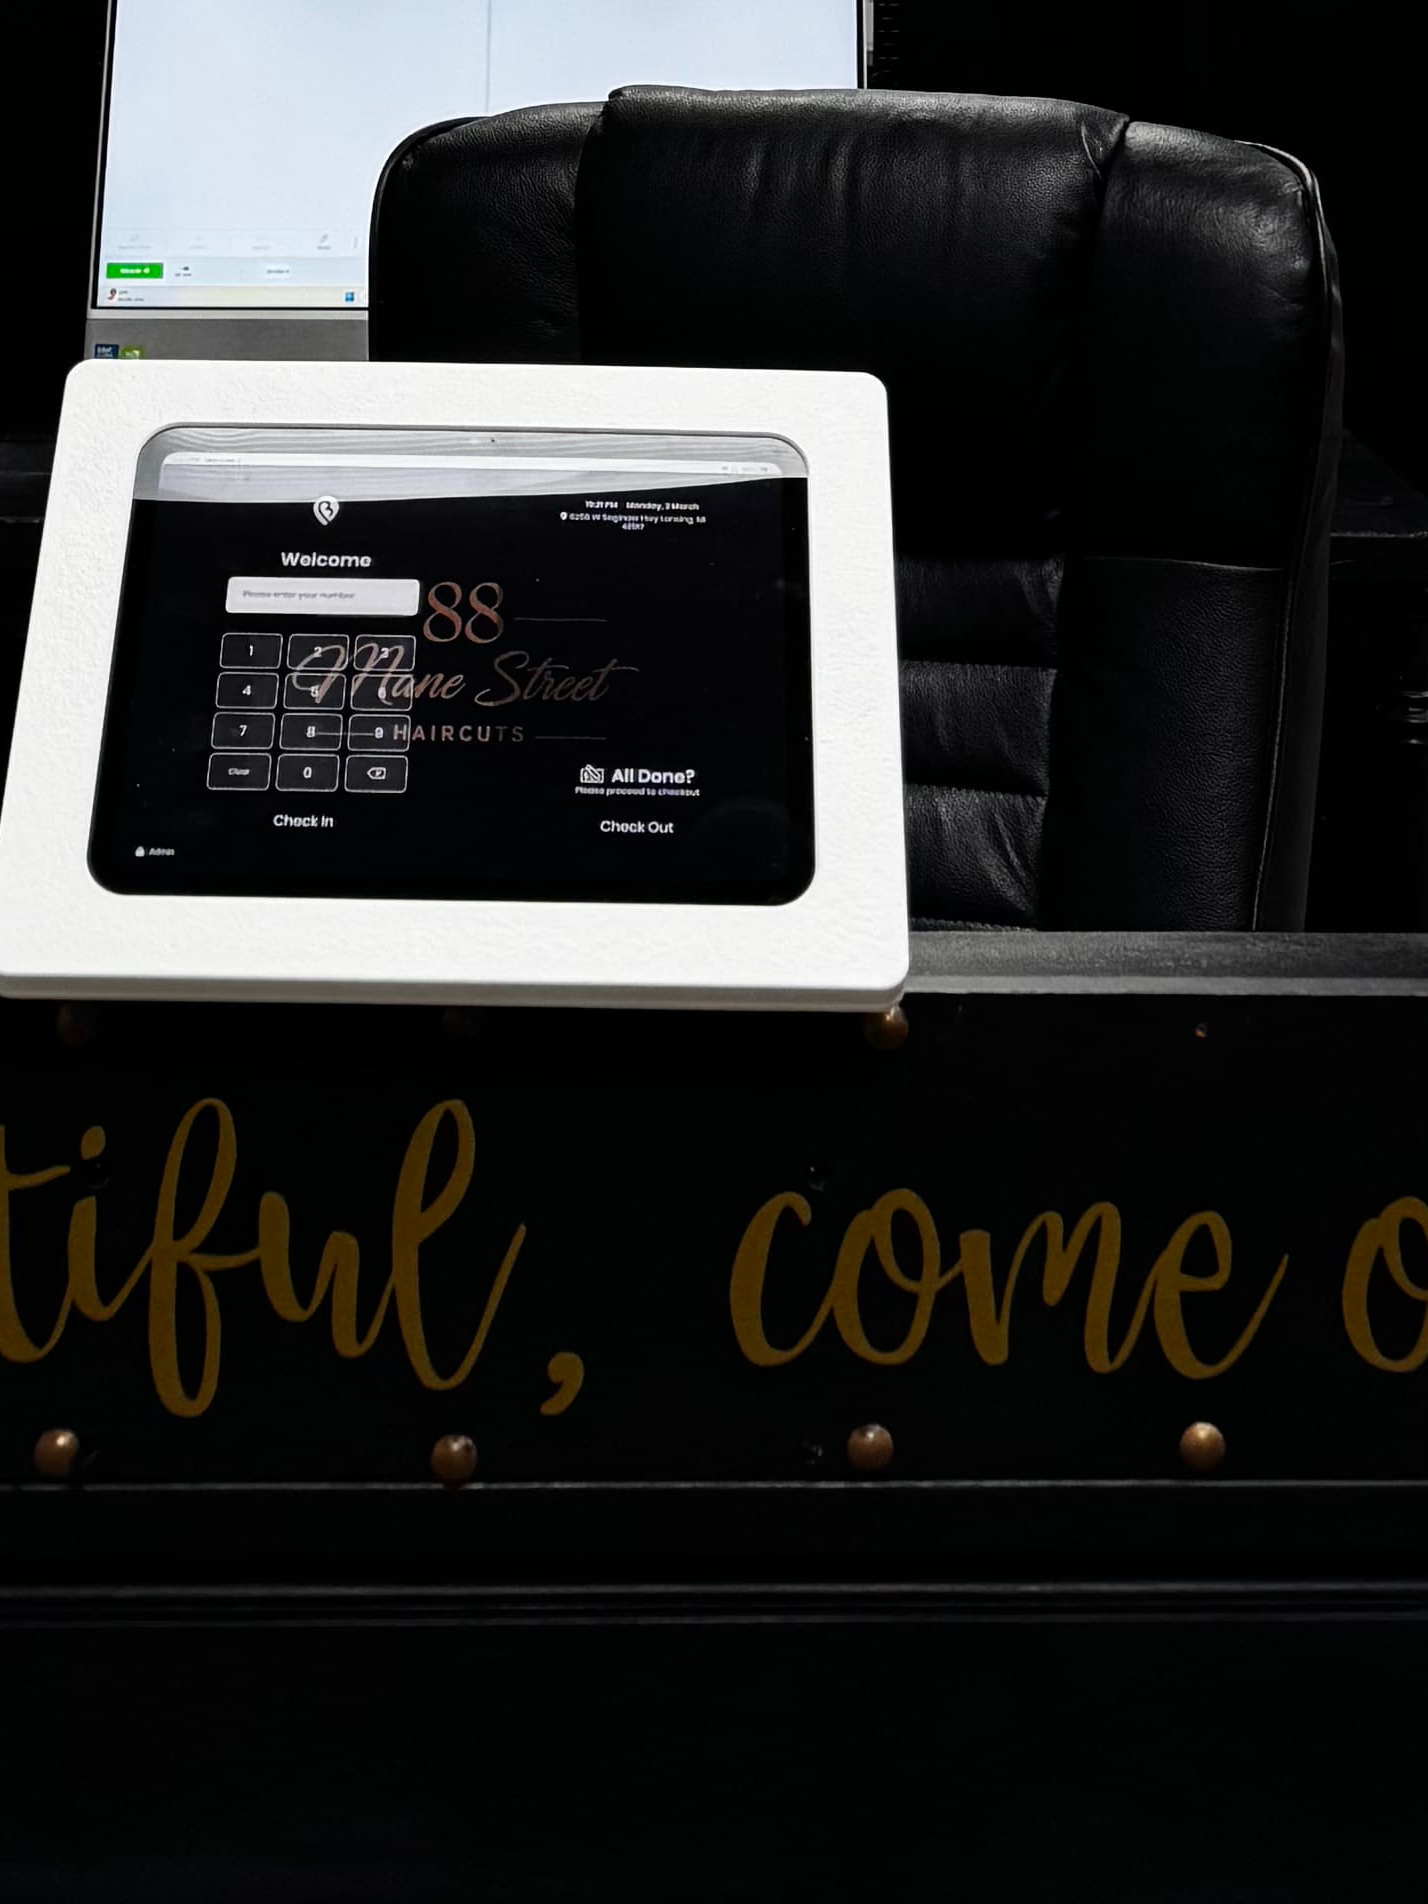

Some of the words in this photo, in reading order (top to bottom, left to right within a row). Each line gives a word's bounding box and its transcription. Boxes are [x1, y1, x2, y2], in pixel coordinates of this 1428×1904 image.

[281, 552, 372, 567] Welcome
[423, 581, 504, 644] 88
[474, 650, 640, 707] Street
[242, 685, 252, 696] 4
[239, 725, 248, 736] 7
[393, 724, 524, 743] HAIRCUTS
[303, 767, 312, 778] 0
[611, 768, 634, 783] All
[638, 769, 695, 784] Done?
[273, 814, 318, 828] Check
[321, 815, 334, 828] In
[600, 820, 645, 833] Check
[648, 821, 674, 833] Out
[729, 1189, 1289, 1380] come
